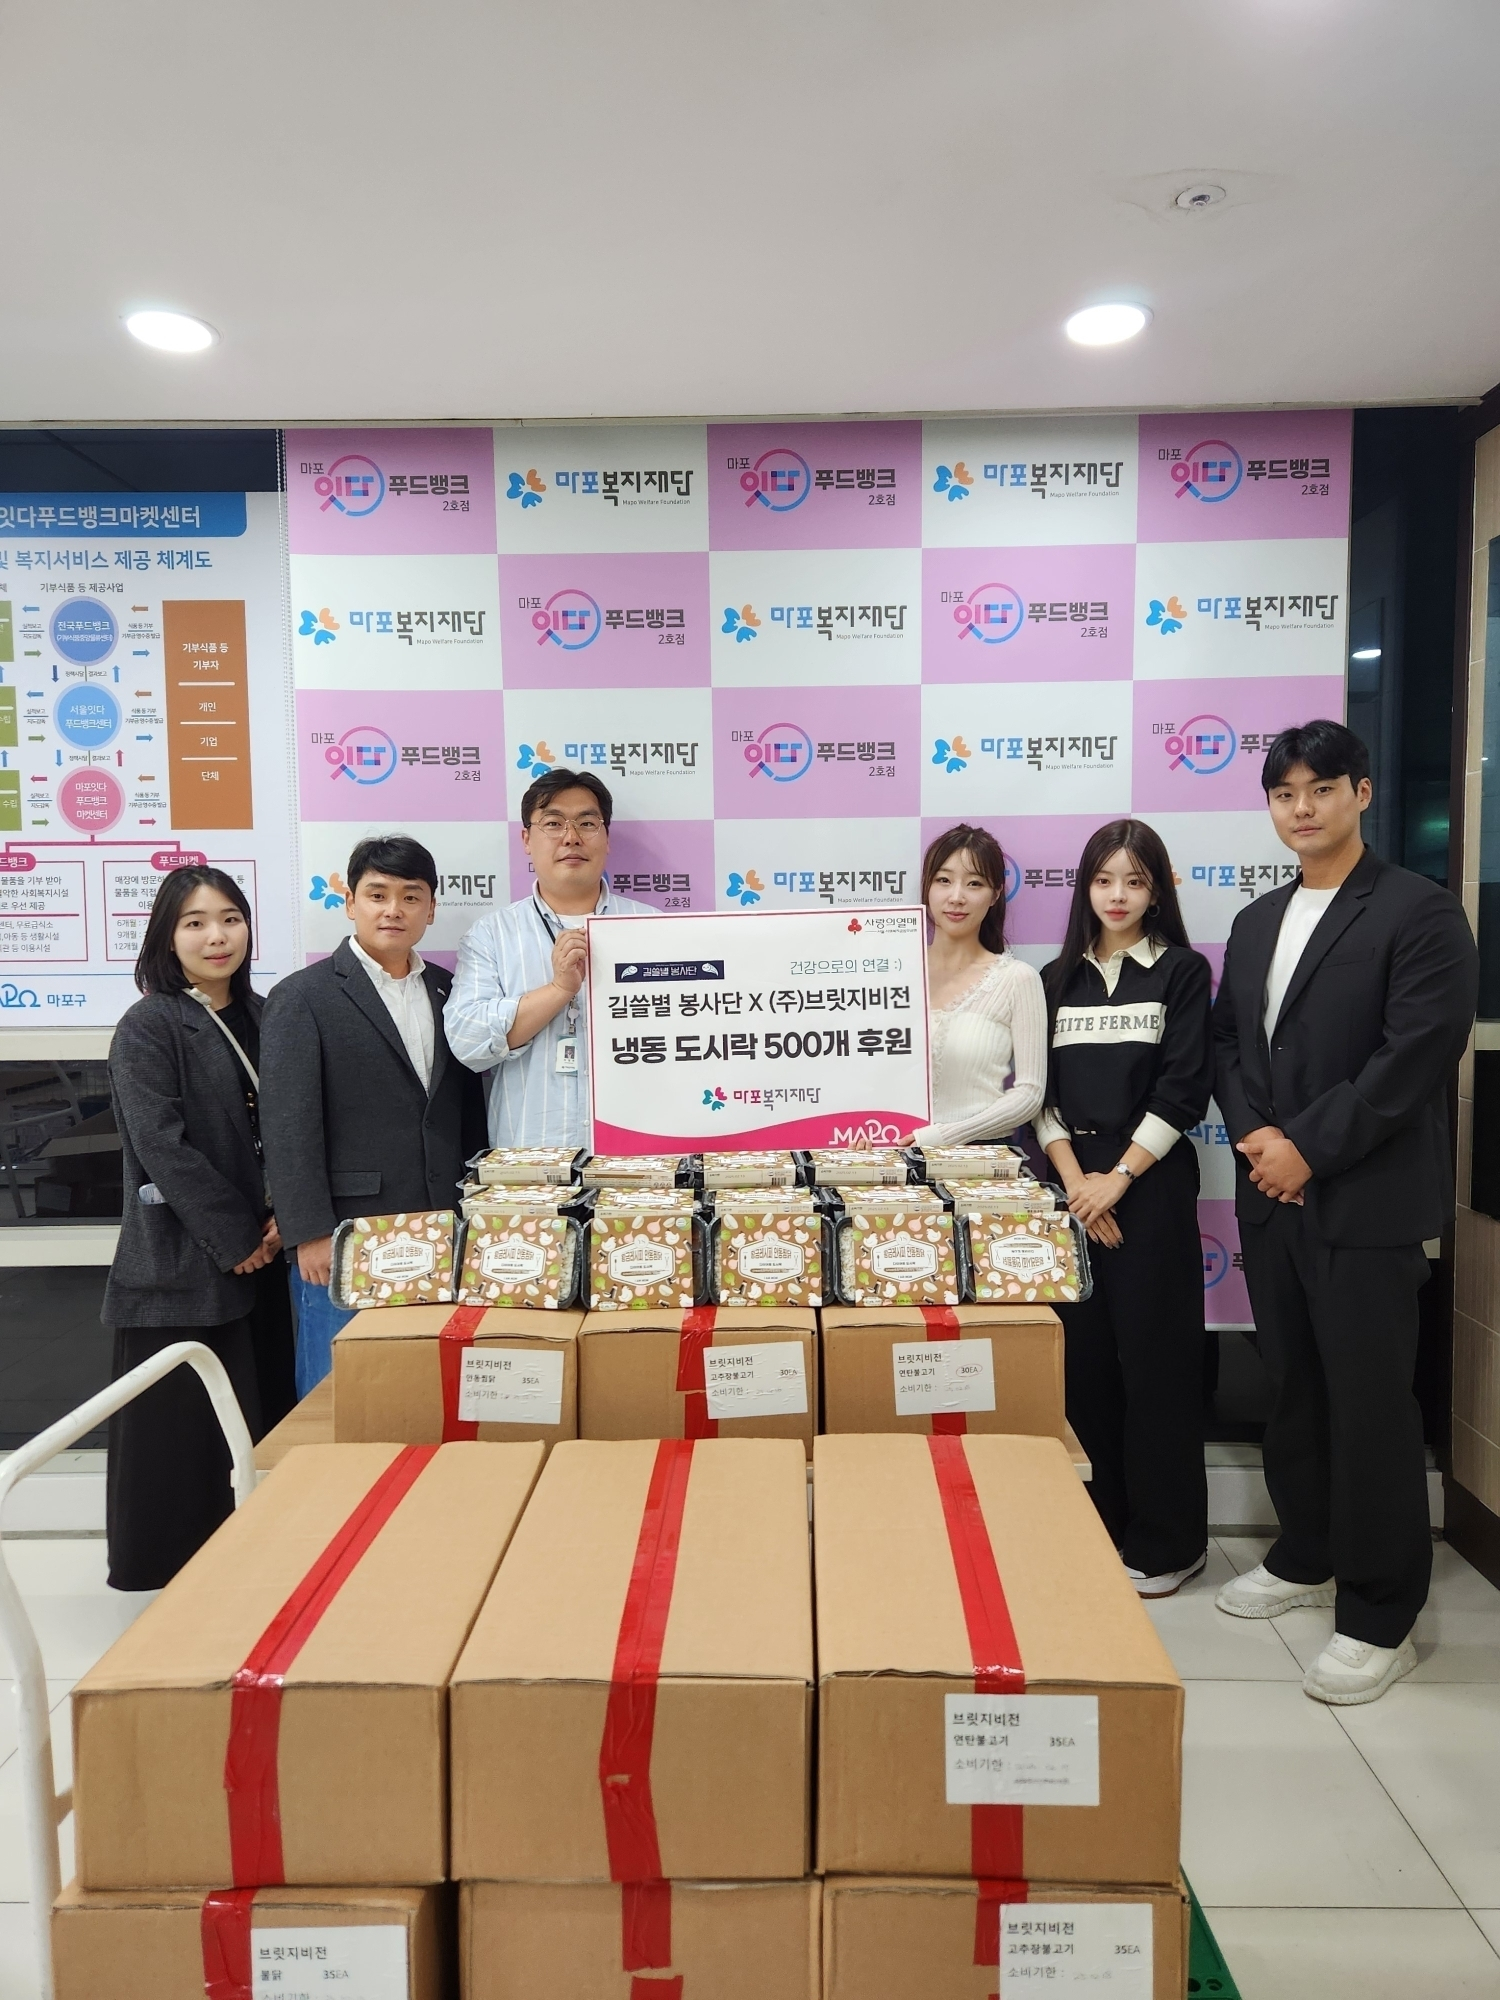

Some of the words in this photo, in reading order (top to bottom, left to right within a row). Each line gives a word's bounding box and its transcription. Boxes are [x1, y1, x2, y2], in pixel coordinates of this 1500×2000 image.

[1159, 449, 1182, 461] 마포
[301, 463, 324, 475] 마포
[727, 458, 750, 469] 마포
[1247, 458, 1330, 480] 푸드뱅크
[815, 468, 896, 490] 푸드뱅크
[984, 462, 1123, 499] 마포복지재단
[389, 475, 469, 496] 푸드뱅크
[556, 470, 693, 506] 마포복지재단
[1302, 484, 1329, 496] 2호점
[868, 494, 896, 506] 2호점
[443, 500, 470, 512] 2호점
[15, 550, 109, 570] 복지서비스
[114, 550, 151, 569] 제공
[157, 550, 213, 569] 체계도
[40, 583, 75, 592] 기부식품
[78, 583, 86, 592] 등
[89, 583, 124, 592] 제공사업
[519, 597, 541, 609] 마포
[941, 592, 964, 603] 마포
[1028, 602, 1108, 622] 푸드뱅크
[1198, 595, 1338, 631] 마포복지재단
[605, 609, 685, 629] 푸드뱅크
[771, 605, 907, 640] 마포복지재단
[58, 621, 110, 631] 전국푸드뱅크
[350, 610, 485, 645] 마포복지재단
[1081, 627, 1108, 638] 2호점
[658, 634, 685, 645] 2호점
[183, 643, 217, 653] 기부식품
[220, 643, 228, 653] 등
[194, 660, 219, 670] 기부자
[70, 705, 105, 715] 서울잇다
[199, 702, 216, 712] 개인
[66, 719, 112, 729] 푸드뱅크센터
[1152, 723, 1175, 734] 마포
[200, 737, 218, 746] 기업
[312, 732, 335, 744] 마포
[732, 730, 754, 742] 마포
[1240, 734, 1275, 753] 푸드
[401, 746, 480, 765] 푸드뱅크
[817, 742, 895, 761] 푸드뱅크
[981, 736, 1117, 771] 마포복지재단
[565, 742, 698, 776] 마포복지재단
[202, 771, 219, 781] 단체
[455, 770, 481, 781] 2호점
[869, 766, 895, 777] 2호점
[76, 782, 107, 792] 마포잇다
[76, 797, 107, 806] 푸드뱅크
[77, 810, 107, 819] 마켓센터
[159, 856, 198, 866] 푸드마켓
[2, 877, 25, 885] 물품을
[28, 877, 43, 885] 기부
[46, 876, 62, 885] 받아
[115, 876, 138, 884] 매장에
[141, 876, 164, 884] 방문하
[613, 873, 691, 893] 푸드뱅크
[1025, 869, 1076, 888] 푸드뱅
[1192, 865, 1301, 898] 마포복지재
[115, 888, 138, 897] 물품을
[774, 871, 906, 904] 마포복지재단
[0, 889, 18, 898] 악한
[21, 889, 69, 897] 사회복지시설
[11, 902, 26, 910] 우선
[29, 902, 45, 910] 제공
[665, 897, 691, 908] 2호점
[17, 921, 53, 929] 무료급식소
[865, 918, 917, 930] 사랑의열매
[21, 933, 28, 941] 등
[30, 932, 59, 941] 생활시설
[118, 931, 137, 939] 9개월
[21, 944, 50, 952] 이용시설
[642, 967, 669, 976] 길쓸별
[671, 967, 697, 976] 봉사단
[790, 959, 857, 975] 건강으로의
[863, 959, 889, 972] 연결
[47, 995, 86, 1007] 마포구
[608, 994, 670, 1018] 길쓸별
[678, 991, 743, 1016] 봉사단
[769, 986, 910, 1014] (주)브릿지비전
[1099, 1015, 1159, 1030] FERME
[612, 1036, 666, 1064] 냉동
[675, 1032, 758, 1061] 도시락
[764, 1030, 849, 1058] 500개
[857, 1028, 912, 1056] 후원
[734, 1088, 821, 1110] 마포복지재단
[709, 1356, 753, 1368] 브릿지비전
[898, 1353, 942, 1364] 브릿지비전
[466, 1360, 512, 1370] 브릿지비전
[710, 1372, 754, 1381] 고추장불고기
[899, 1368, 935, 1377] 연탄불고기
[466, 1375, 495, 1383] 안동찜닭
[953, 1712, 1020, 1727] 브릿지비전
[954, 1735, 1009, 1746] 연탄불고기
[1007, 1922, 1074, 1935] 브릿지비전
[259, 1947, 327, 1960] 브릿지비전
[1008, 1944, 1074, 1955] 고추장불고기
[261, 1970, 282, 1981] 불닭
